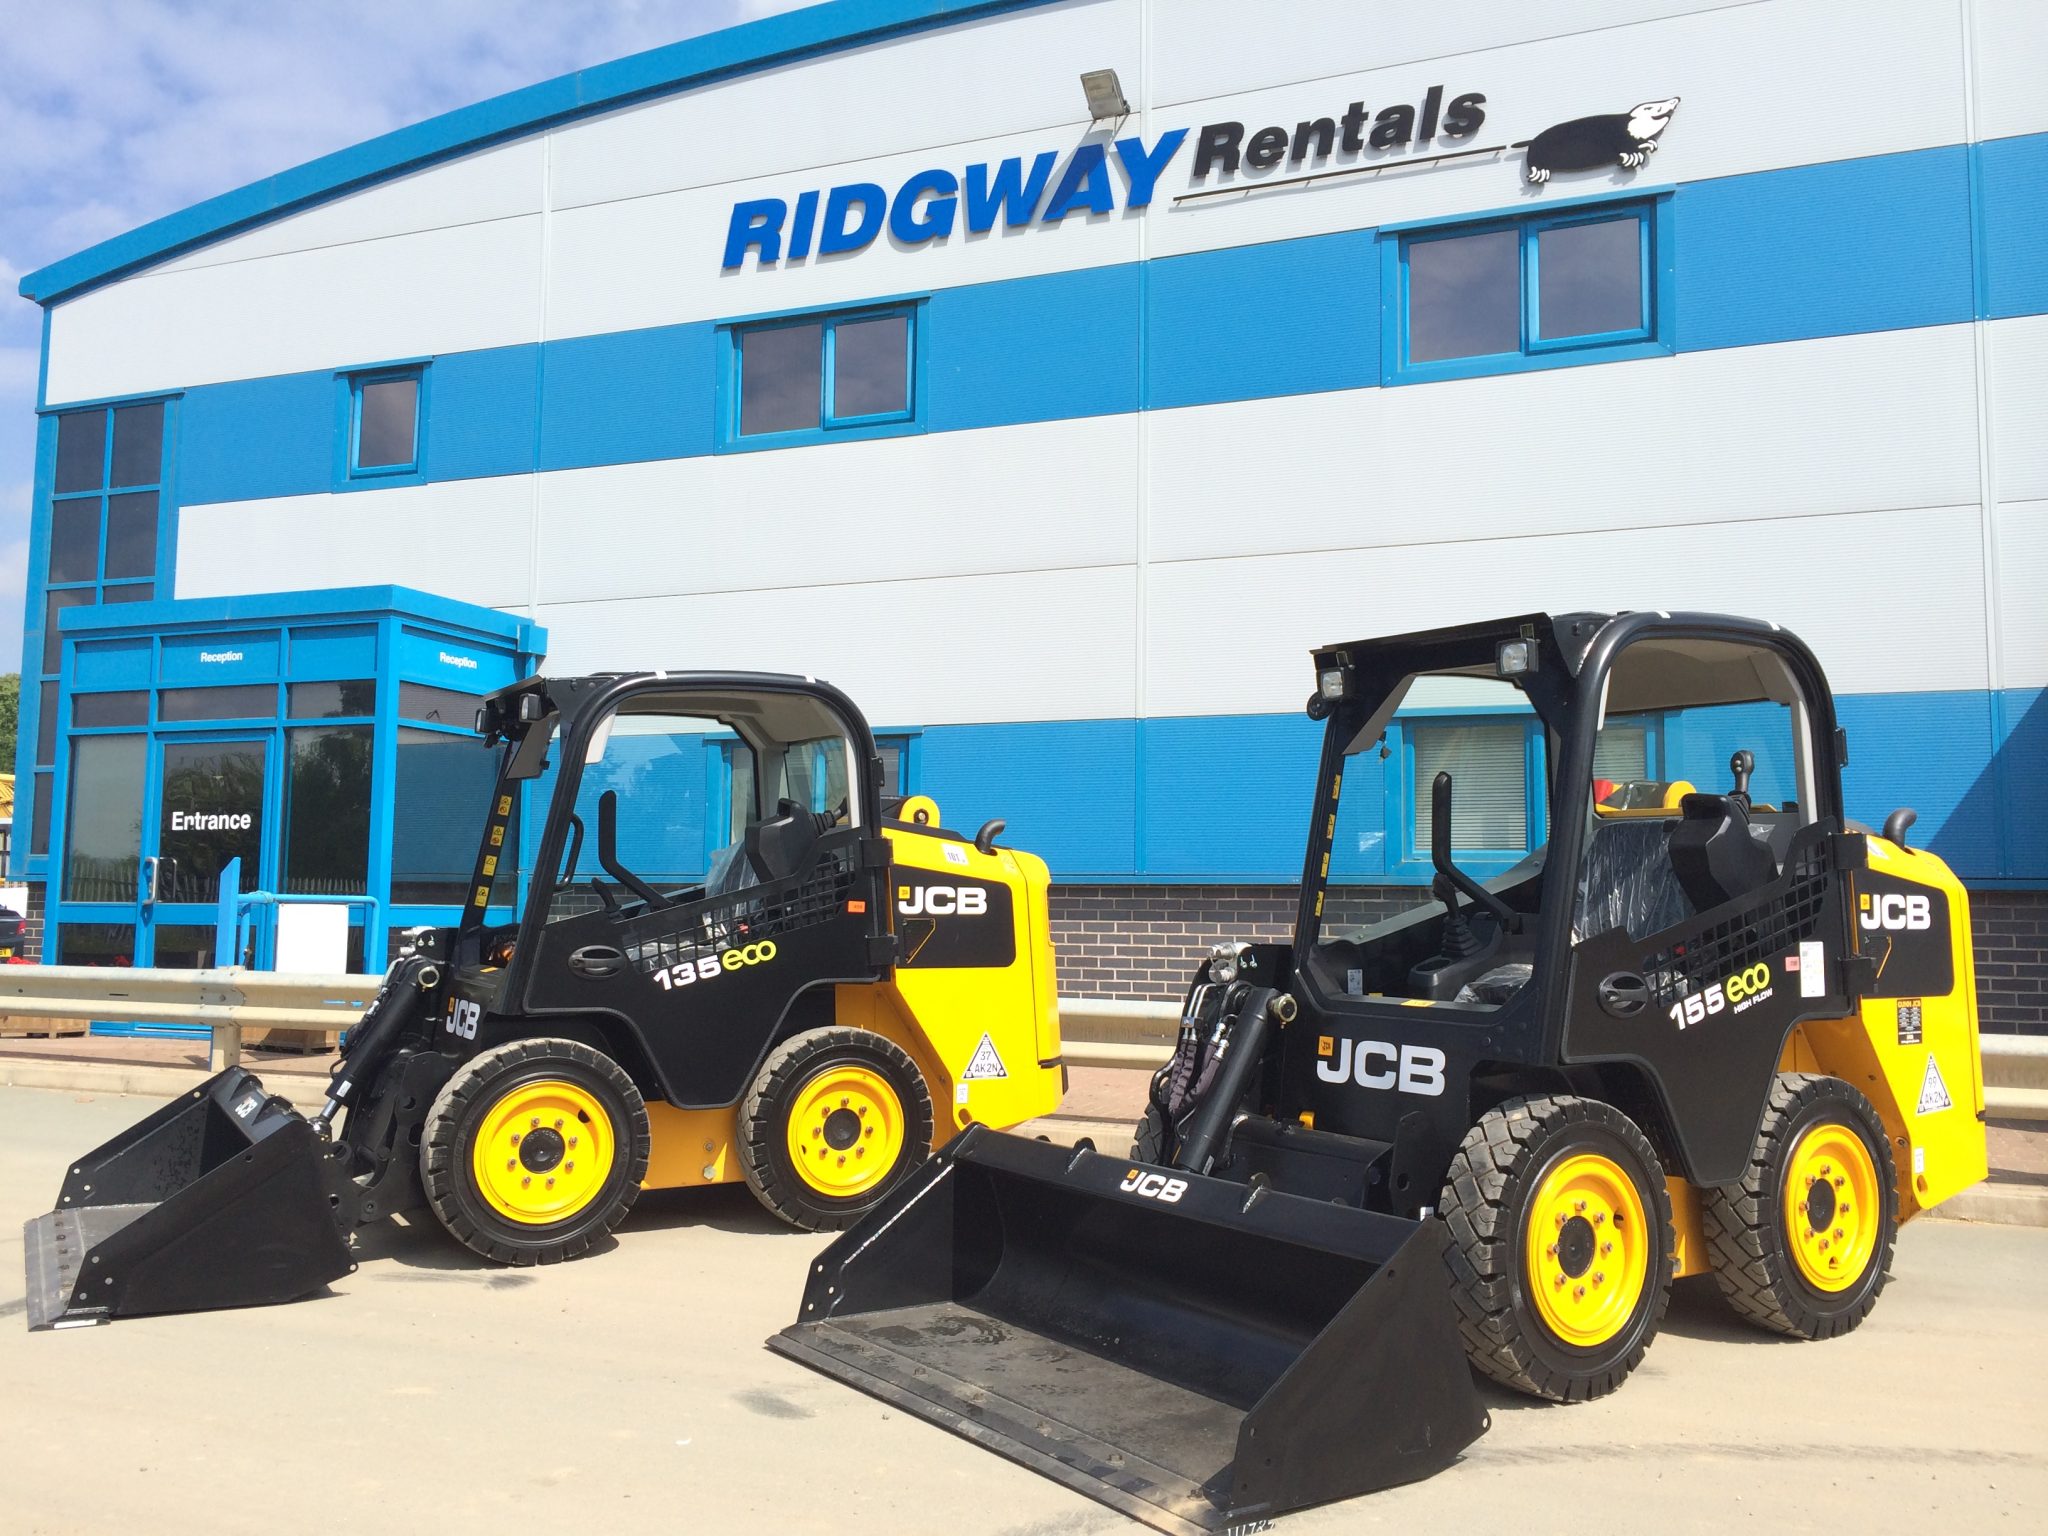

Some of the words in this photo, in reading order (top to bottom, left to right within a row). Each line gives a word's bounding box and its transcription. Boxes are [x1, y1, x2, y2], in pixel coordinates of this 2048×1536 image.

[722, 127, 1190, 269] RIDGWAY
[1193, 85, 1487, 177] Rentals
[200, 651, 243, 664] Reception
[439, 651, 478, 669] Reception
[171, 811, 252, 831] Entrance
[898, 886, 988, 915] JCB
[1860, 894, 1931, 930] JCB
[653, 954, 722, 991] 135
[722, 940, 777, 971] eco
[1669, 983, 1725, 1030] 155
[1726, 962, 1770, 1002] eco
[1733, 999, 1753, 1014] HIGH
[1752, 987, 1773, 1005] FLOW
[446, 996, 481, 1040] JCB
[974, 1063, 998, 1073] AK2N
[980, 1050, 992, 1061] 37
[1316, 1036, 1446, 1096] JCB
[234, 1096, 258, 1119] JCB
[1120, 1169, 1188, 1203] JCB
